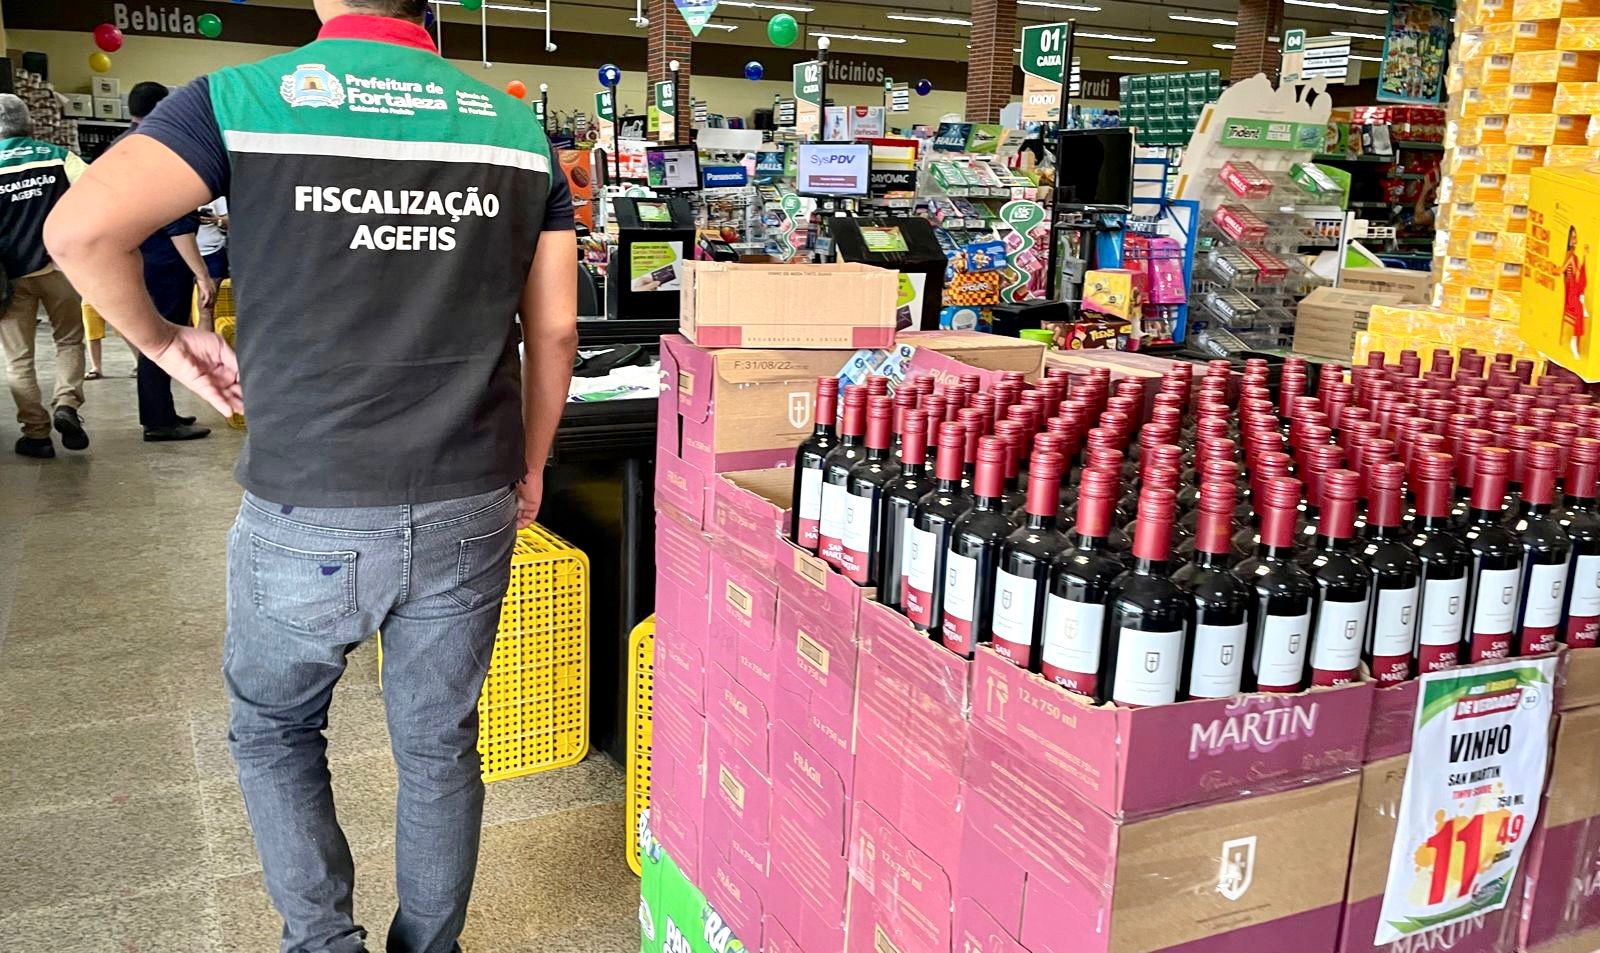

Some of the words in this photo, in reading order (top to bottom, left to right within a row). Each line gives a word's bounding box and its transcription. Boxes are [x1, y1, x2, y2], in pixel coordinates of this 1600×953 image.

[113, 3, 200, 34] Bebida
[1040, 29, 1060, 52] 01
[1036, 55, 1061, 66] CAIXA
[804, 65, 818, 83] 02
[828, 59, 884, 83] ticinios
[345, 74, 422, 93] Prefeitura
[425, 81, 444, 95] de
[1081, 79, 1110, 99] fruti
[347, 88, 448, 110] Fortaleza
[1228, 125, 1260, 140] Trident
[934, 138, 965, 147] HALLS
[756, 163, 783, 171] HALLS
[810, 154, 857, 167] SysPDV
[0, 175, 56, 194] SCALIZAÇÃO
[706, 172, 745, 182] Panasonic
[11, 188, 43, 202] AGEFIS
[295, 186, 500, 223] FISCALIZAÇÃO
[349, 225, 456, 251] AGEFIS
[996, 643, 1011, 658] SAN
[1055, 675, 1078, 689] SAN
[1449, 724, 1512, 763] VINHO
[1448, 773, 1468, 787] SAN
[1497, 814, 1524, 845] 49
[1426, 814, 1485, 906] 11
